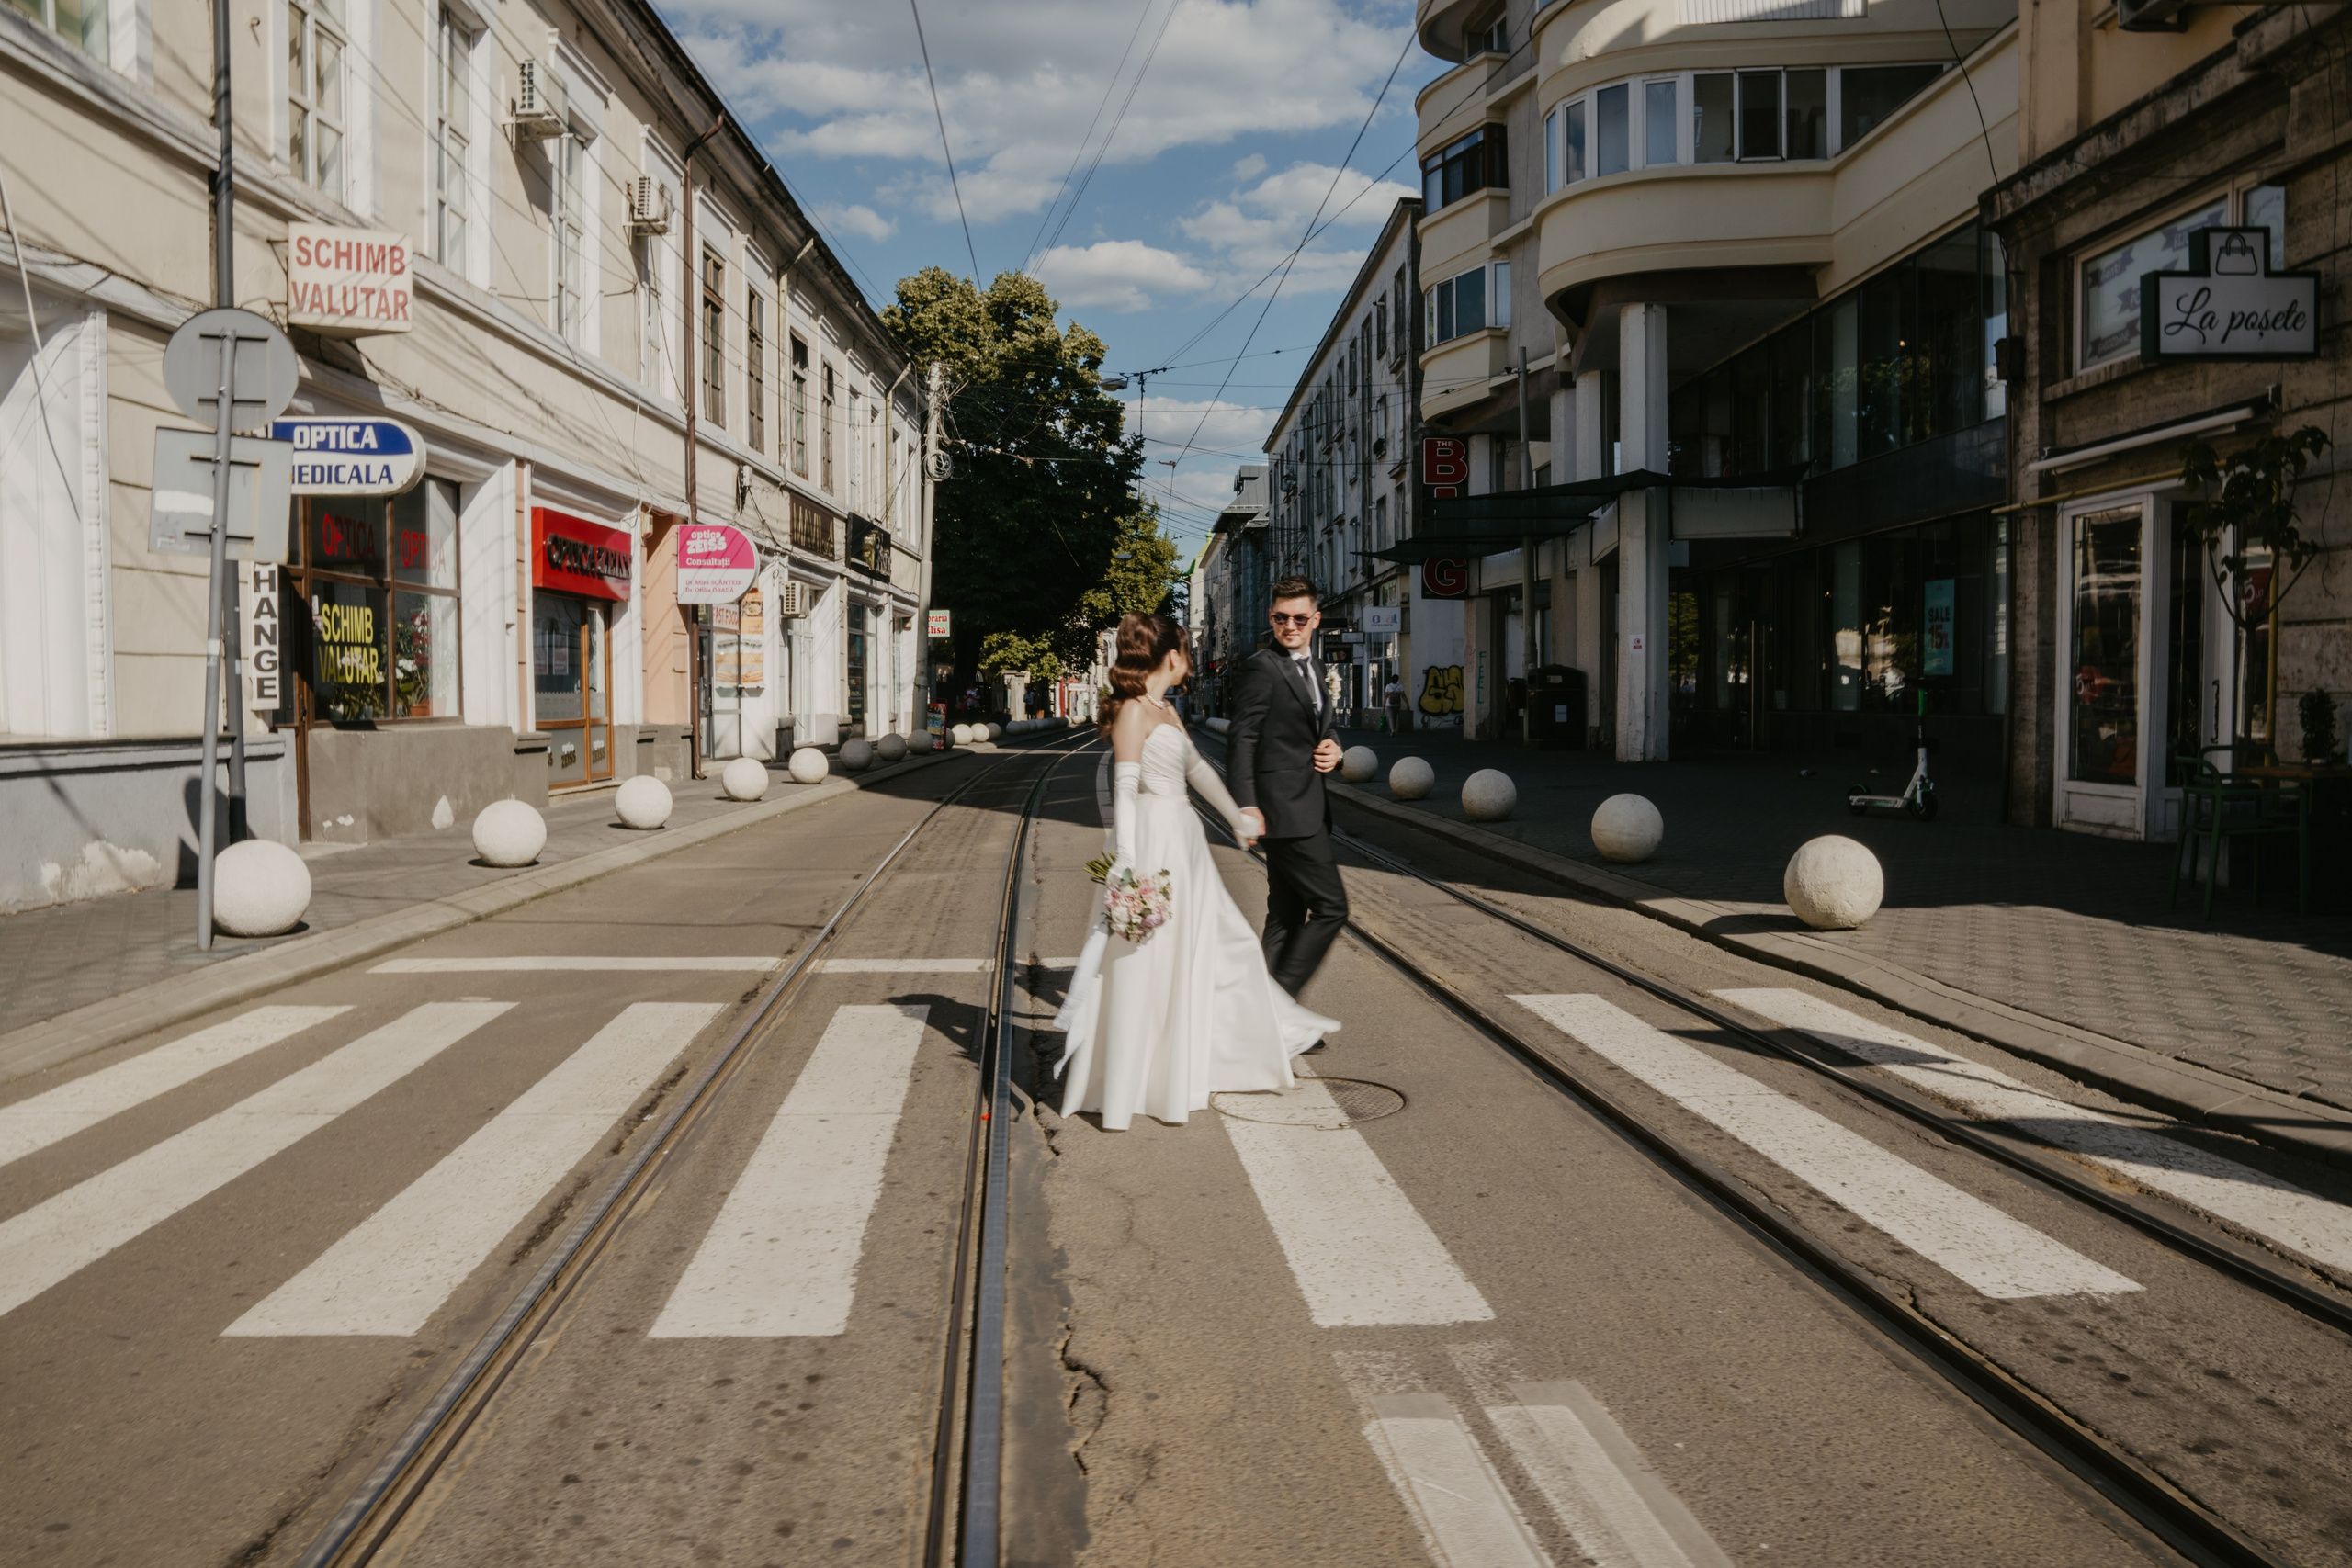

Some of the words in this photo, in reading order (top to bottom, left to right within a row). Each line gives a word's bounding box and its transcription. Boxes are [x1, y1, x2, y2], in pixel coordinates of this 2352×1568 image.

[296, 236, 405, 276] SCHIMB
[291, 281, 410, 321] VALUTAR
[2164, 287, 2219, 345] La
[293, 425, 379, 449] OPTICA
[691, 529, 722, 542] optica
[1423, 437, 1468, 597] BG
[322, 513, 376, 562] OPTICA
[401, 528, 447, 573] OPTICA
[548, 534, 597, 576] OPTICA
[686, 536, 728, 554] ZEISS
[2244, 577, 2256, 604] 5
[254, 562, 278, 699] HANGE
[322, 603, 374, 644] SCHIMB
[713, 606, 725, 624] FAST
[725, 609, 739, 626] FOOD
[1928, 607, 1950, 622] SALE
[319, 645, 379, 684] VALUTAR
[1477, 651, 1487, 704] FEEL
[561, 750, 576, 769] ZEISS
